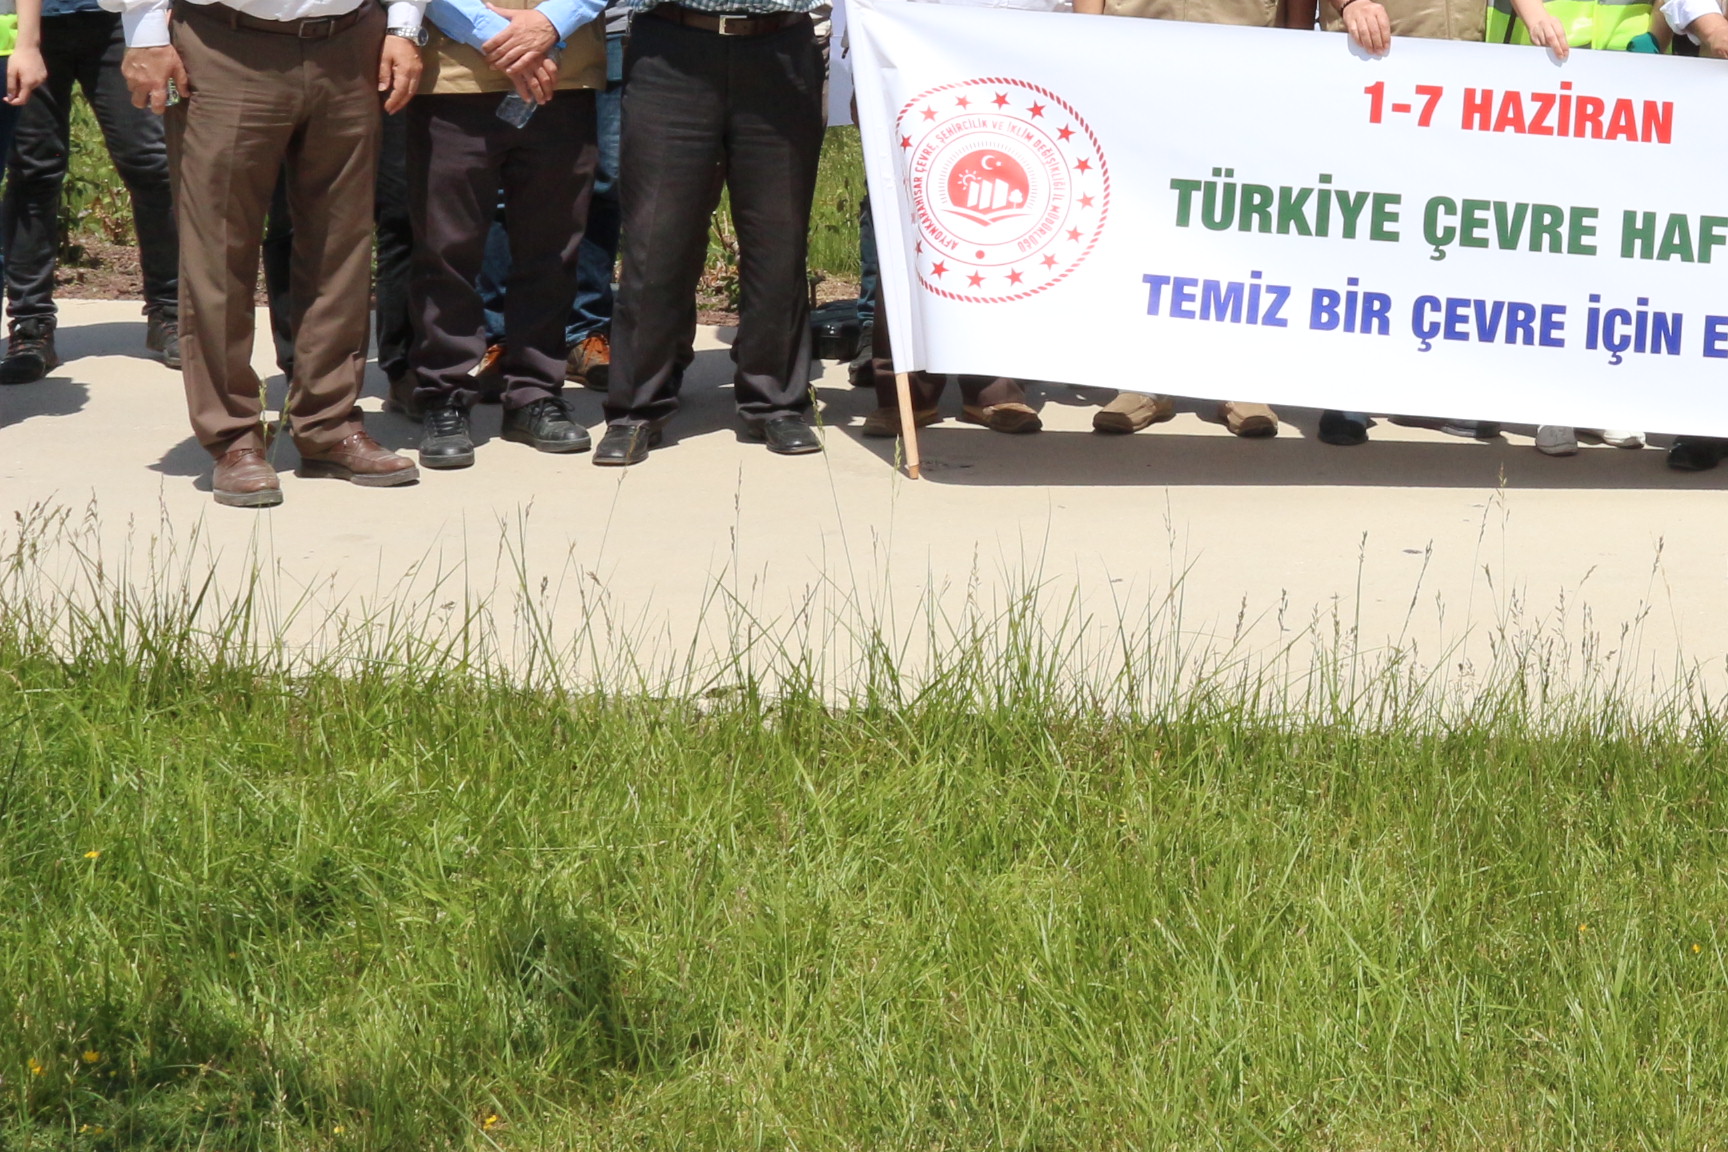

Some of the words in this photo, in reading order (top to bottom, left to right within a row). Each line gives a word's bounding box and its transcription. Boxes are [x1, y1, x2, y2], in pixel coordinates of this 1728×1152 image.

[935, 117, 988, 144] ŞEHİRCİLİK
[992, 120, 1004, 130] VE
[1007, 121, 1035, 143] İKLİM
[1364, 81, 1445, 129] 1-7
[1461, 81, 1675, 145] HAZİRAN
[1169, 167, 1402, 243] TÜRKİYE
[1423, 196, 1599, 260] ÇEVRE
[1142, 270, 1293, 328] TEMİZ
[1310, 277, 1393, 337] BİR
[1412, 295, 1568, 353] ÇEVRE
[1586, 293, 1684, 366] İÇİN
